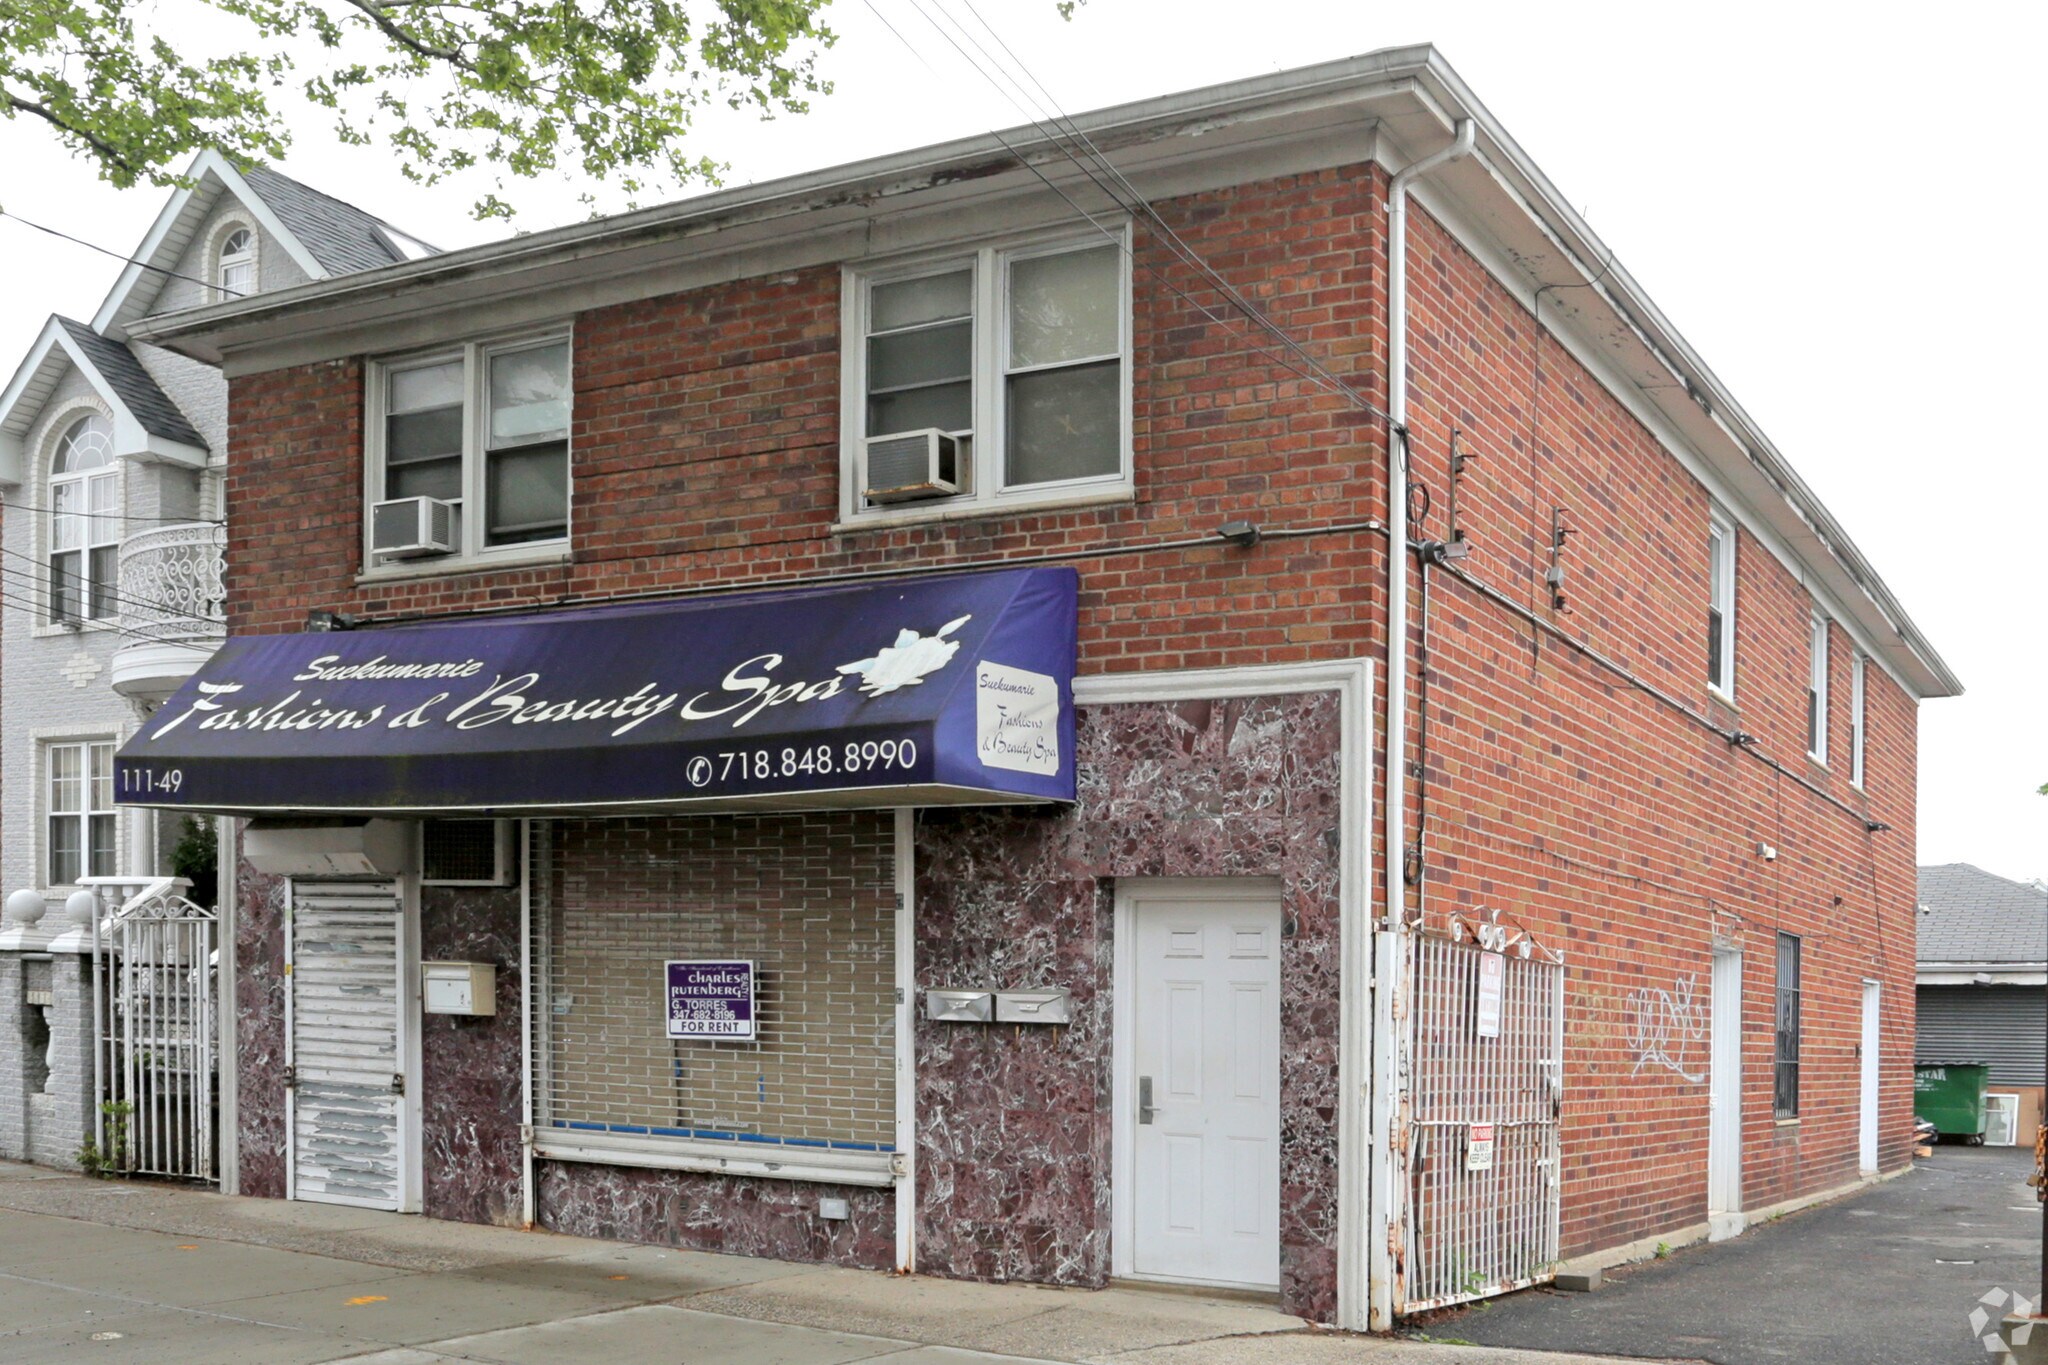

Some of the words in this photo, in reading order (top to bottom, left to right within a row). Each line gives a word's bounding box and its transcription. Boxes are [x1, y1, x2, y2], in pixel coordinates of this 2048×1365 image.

[293, 655, 484, 681] Suekumarie
[151, 681, 387, 740] Fashions
[446, 672, 679, 737] Beauty
[680, 653, 845, 728] Spa
[979, 673, 1036, 696] Suekumarie
[997, 704, 1043, 729] Fashions
[719, 739, 916, 781] 718.848.8990
[993, 731, 1032, 763] Beauty
[1033, 735, 1056, 764] Spa
[122, 769, 182, 793] 111-49
[671, 1000, 683, 1010] G.
[686, 1000, 728, 1011] TORRES
[681, 1021, 705, 1032] FOR
[708, 1022, 739, 1032] RENT
